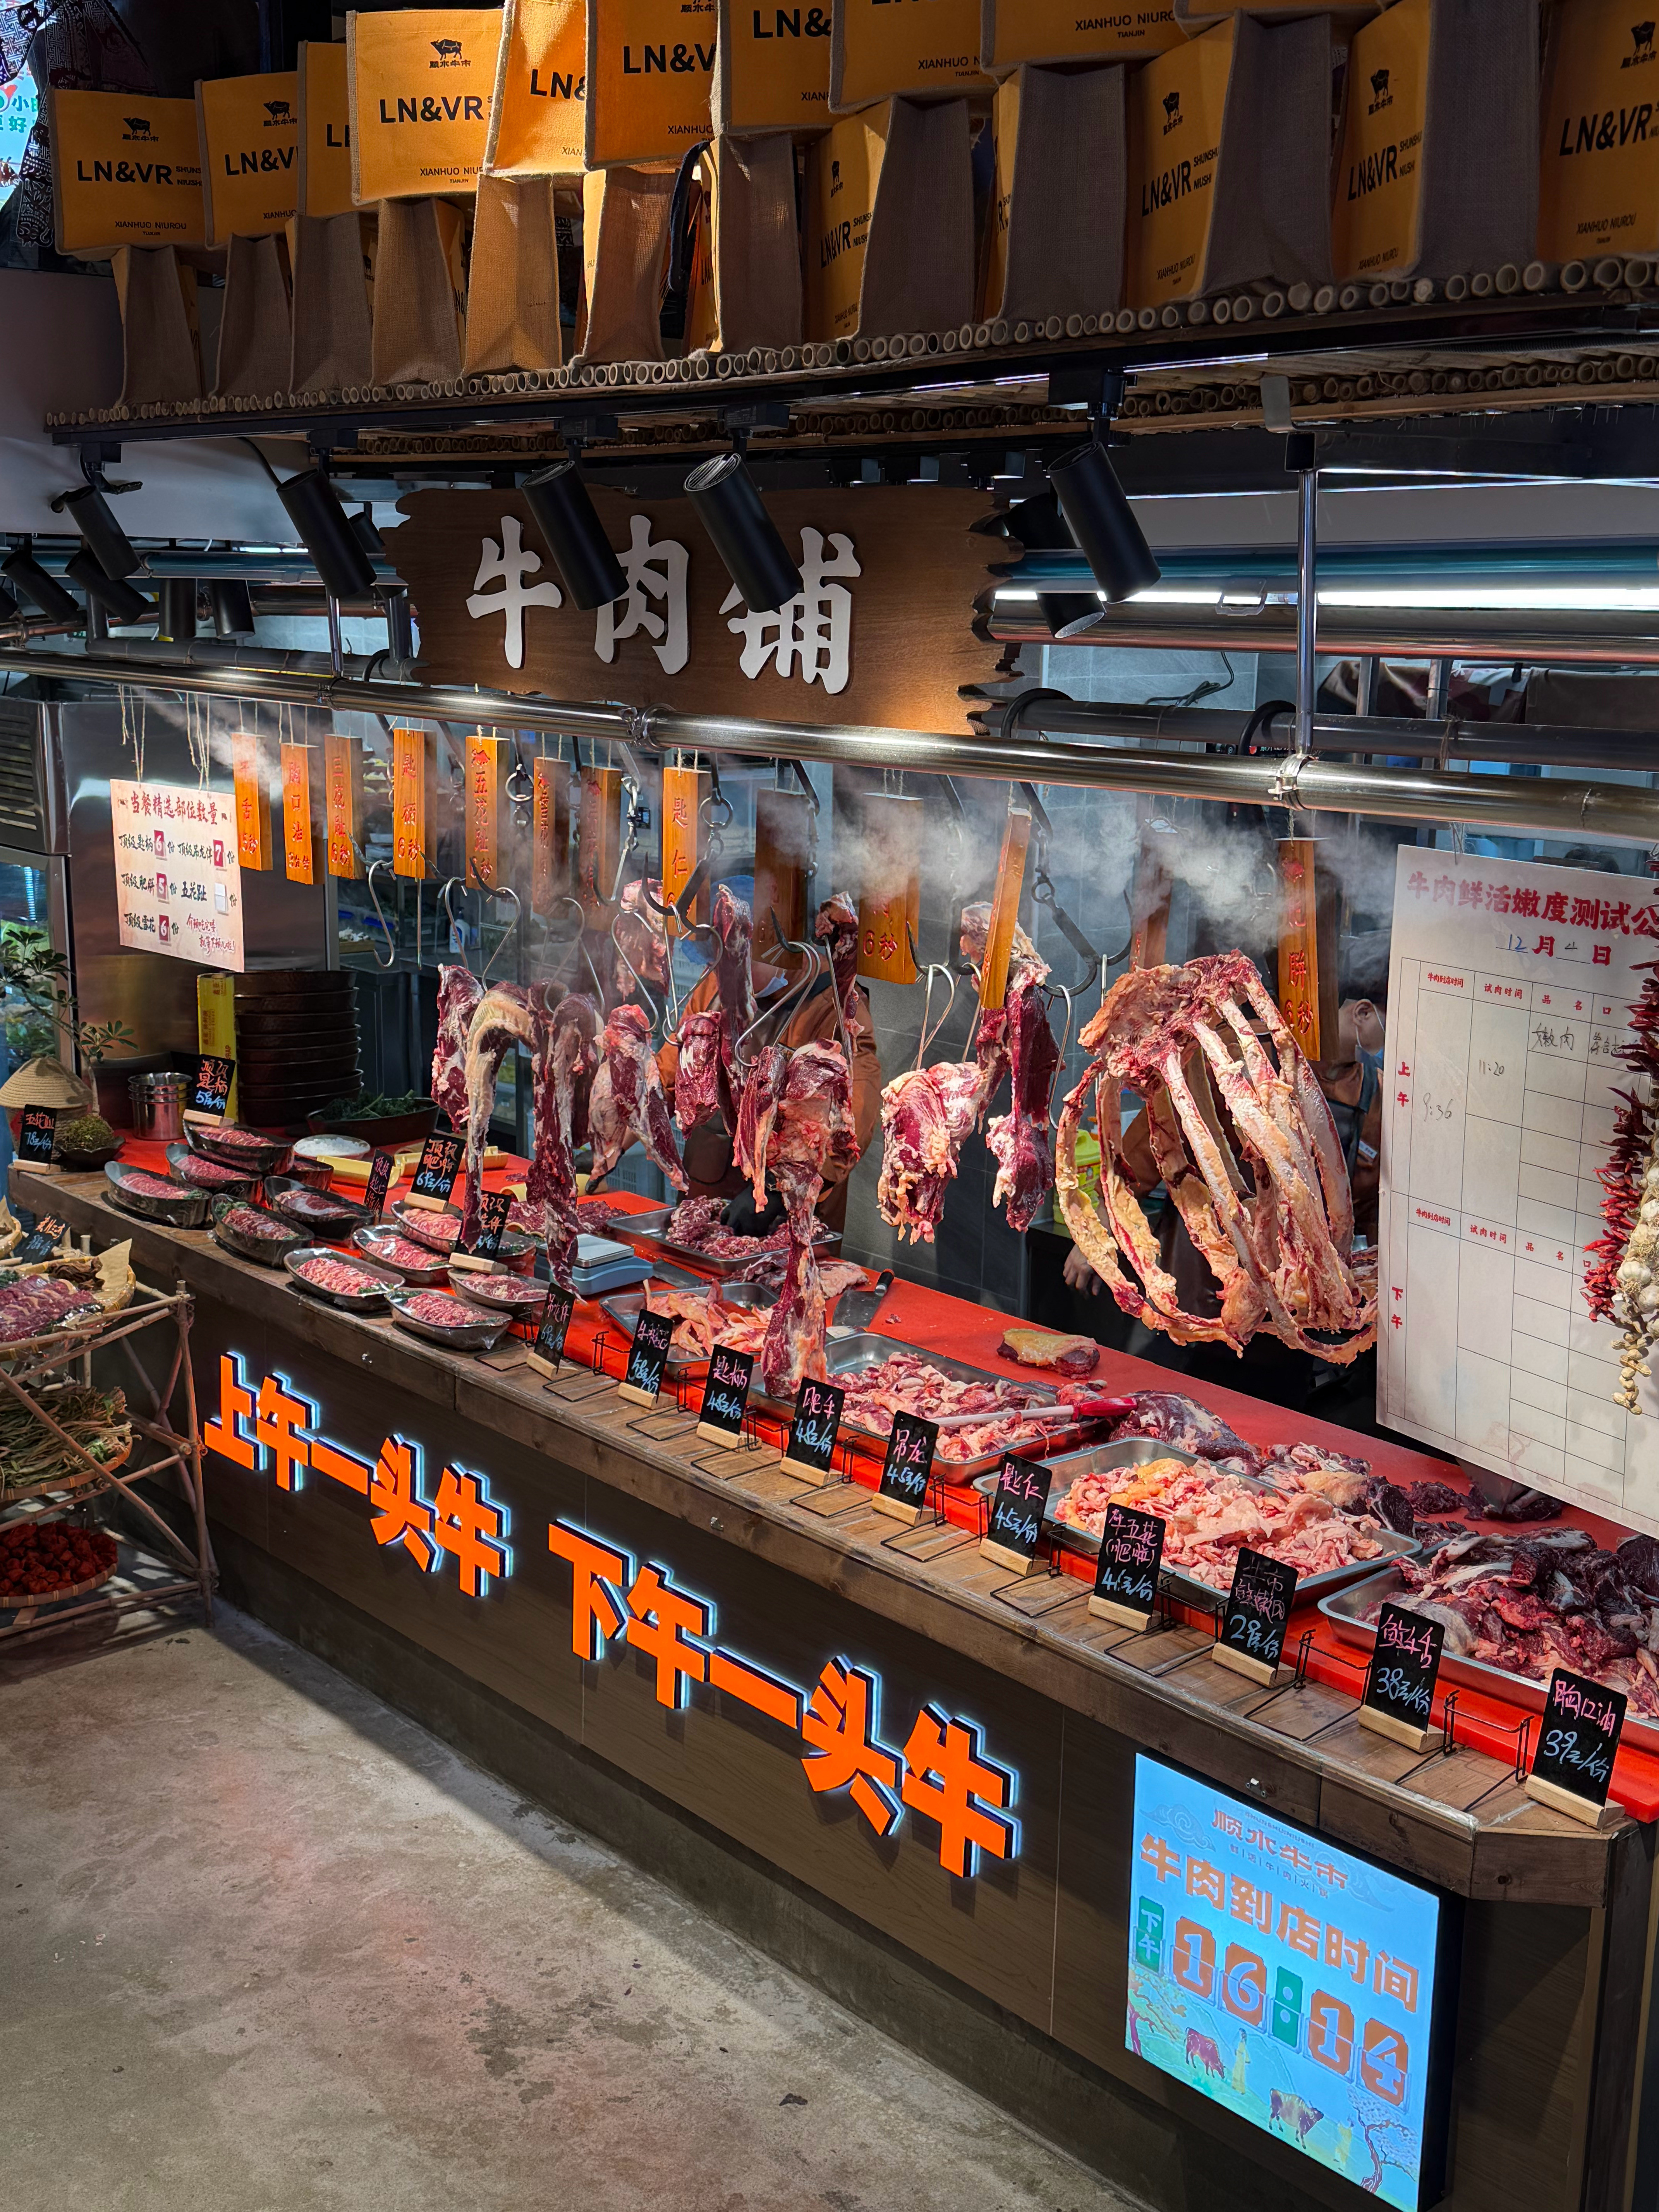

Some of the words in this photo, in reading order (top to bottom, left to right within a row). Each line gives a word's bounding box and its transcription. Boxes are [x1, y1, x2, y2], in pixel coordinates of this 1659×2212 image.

[1075, 15, 1131, 31] XIANHUO
[918, 57, 969, 70] XIANHUO
[380, 96, 484, 123] LN&VR
[1559, 103, 1653, 156] LN&VR
[77, 160, 173, 185] LN&VR
[225, 146, 298, 176] LN&V
[420, 167, 460, 176] XIANHUO
[1348, 144, 1397, 201] LN&VR
[1142, 160, 1192, 217] LN&VR
[155, 222, 187, 230] NIUROU
[821, 220, 851, 269] LN&VR
[131, 790, 218, 825] 当餐精选部位数量
[672, 797, 689, 878] 匙仁
[862, 930, 898, 962] 6秒
[1508, 934, 1528, 952] 12
[1532, 935, 1554, 957] 月
[1592, 944, 1612, 966] 日
[1427, 972, 1464, 988] 牛肉到店时间
[1484, 983, 1523, 1000] 试肉时间
[1285, 999, 1314, 1035] 6秒
[1479, 1060, 1504, 1076] 11:20
[1416, 1207, 1451, 1226] 牛肉到店时间
[1470, 1224, 1507, 1244] 试肉时间
[204, 1352, 508, 1598] 上午一头牛
[548, 1521, 1015, 1878] 下午一头牛
[1212, 1808, 1348, 1889] 顺水牛市
[1140, 1832, 1419, 2013] 牛肉到店时间
